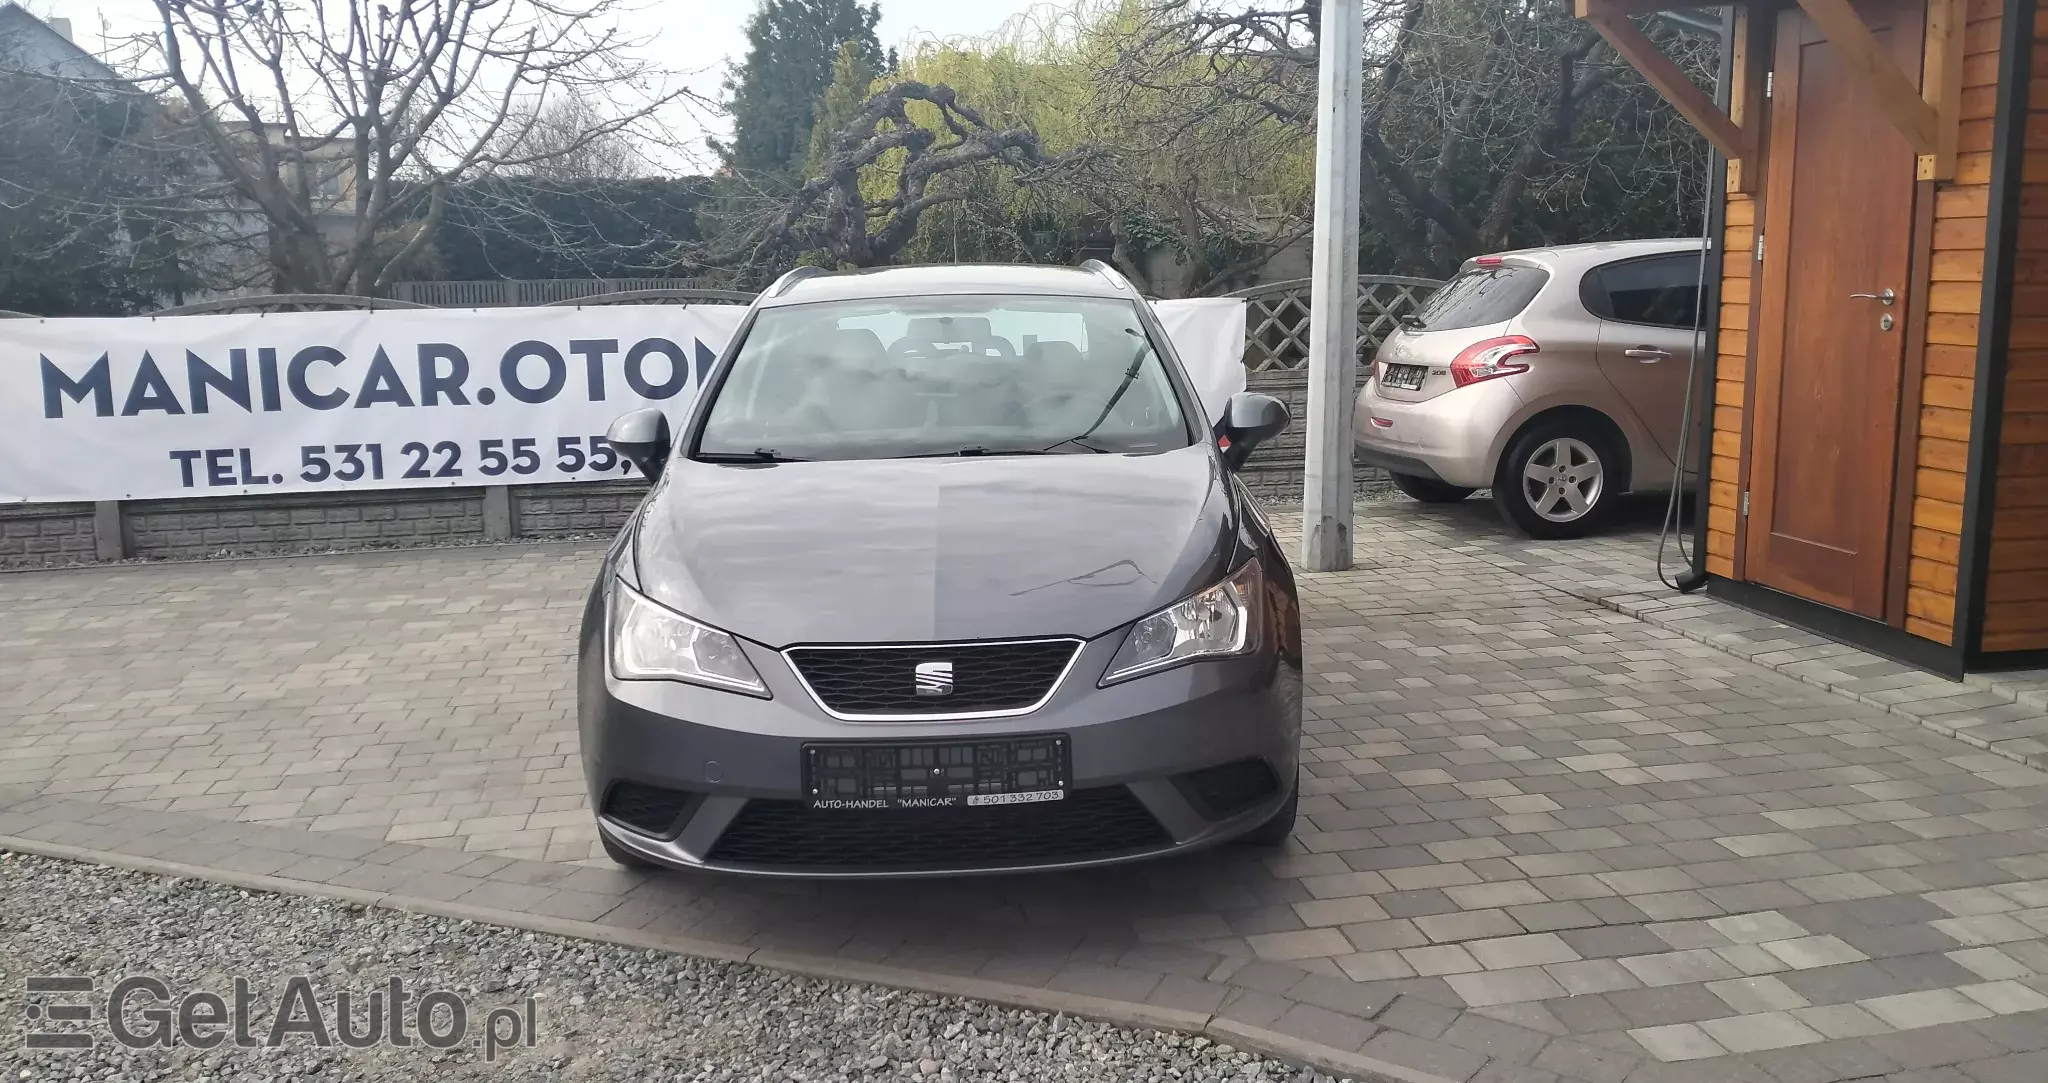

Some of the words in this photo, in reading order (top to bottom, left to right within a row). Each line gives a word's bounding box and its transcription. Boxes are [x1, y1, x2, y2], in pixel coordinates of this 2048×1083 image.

[169, 448, 284, 488] TEL.
[300, 444, 384, 482] 531
[401, 440, 463, 479] 22
[479, 437, 541, 476] 55
[556, 435, 632, 475] 55,
[813, 799, 889, 809] AUTO-HANDEL
[897, 796, 957, 808] "MANICAR"
[983, 795, 1006, 804] 501
[1009, 793, 1033, 803] 332
[1036, 791, 1059, 801] 703
